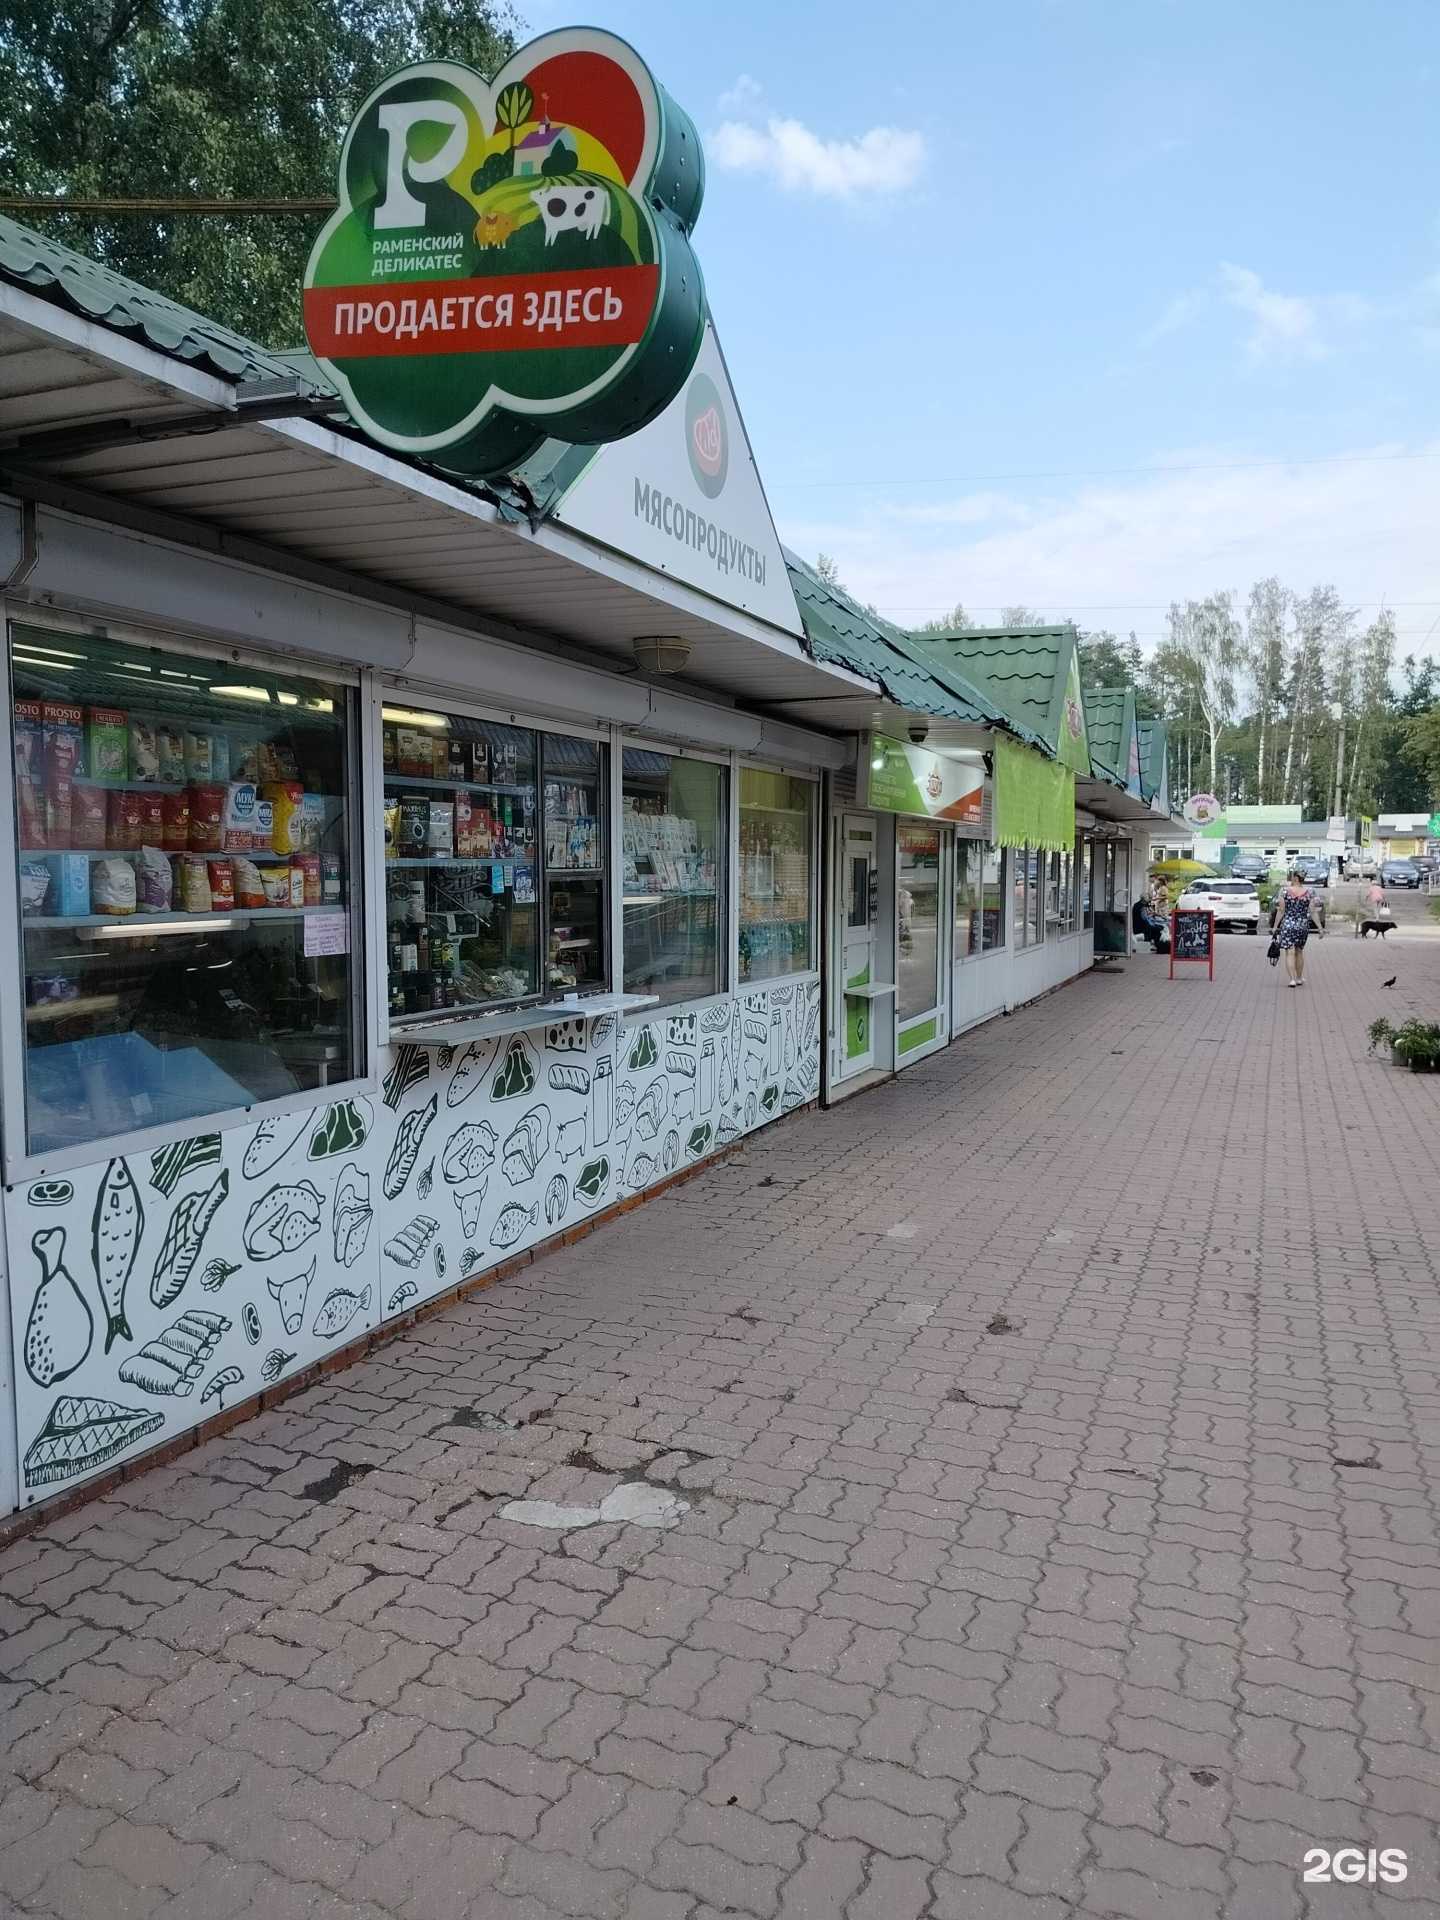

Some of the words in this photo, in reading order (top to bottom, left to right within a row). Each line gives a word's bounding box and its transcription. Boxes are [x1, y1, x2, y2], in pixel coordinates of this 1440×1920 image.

[372, 232, 464, 255] РАМЕНСКИЙ
[371, 253, 463, 277] ДЕЛИКАТЕС
[334, 293, 515, 340] ПРОДАЕТСЯ
[521, 286, 624, 332] ЗДЕСЬ
[633, 476, 767, 587] МЯСОПРОДУКТЫ
[44, 706, 81, 720] PROSTO
